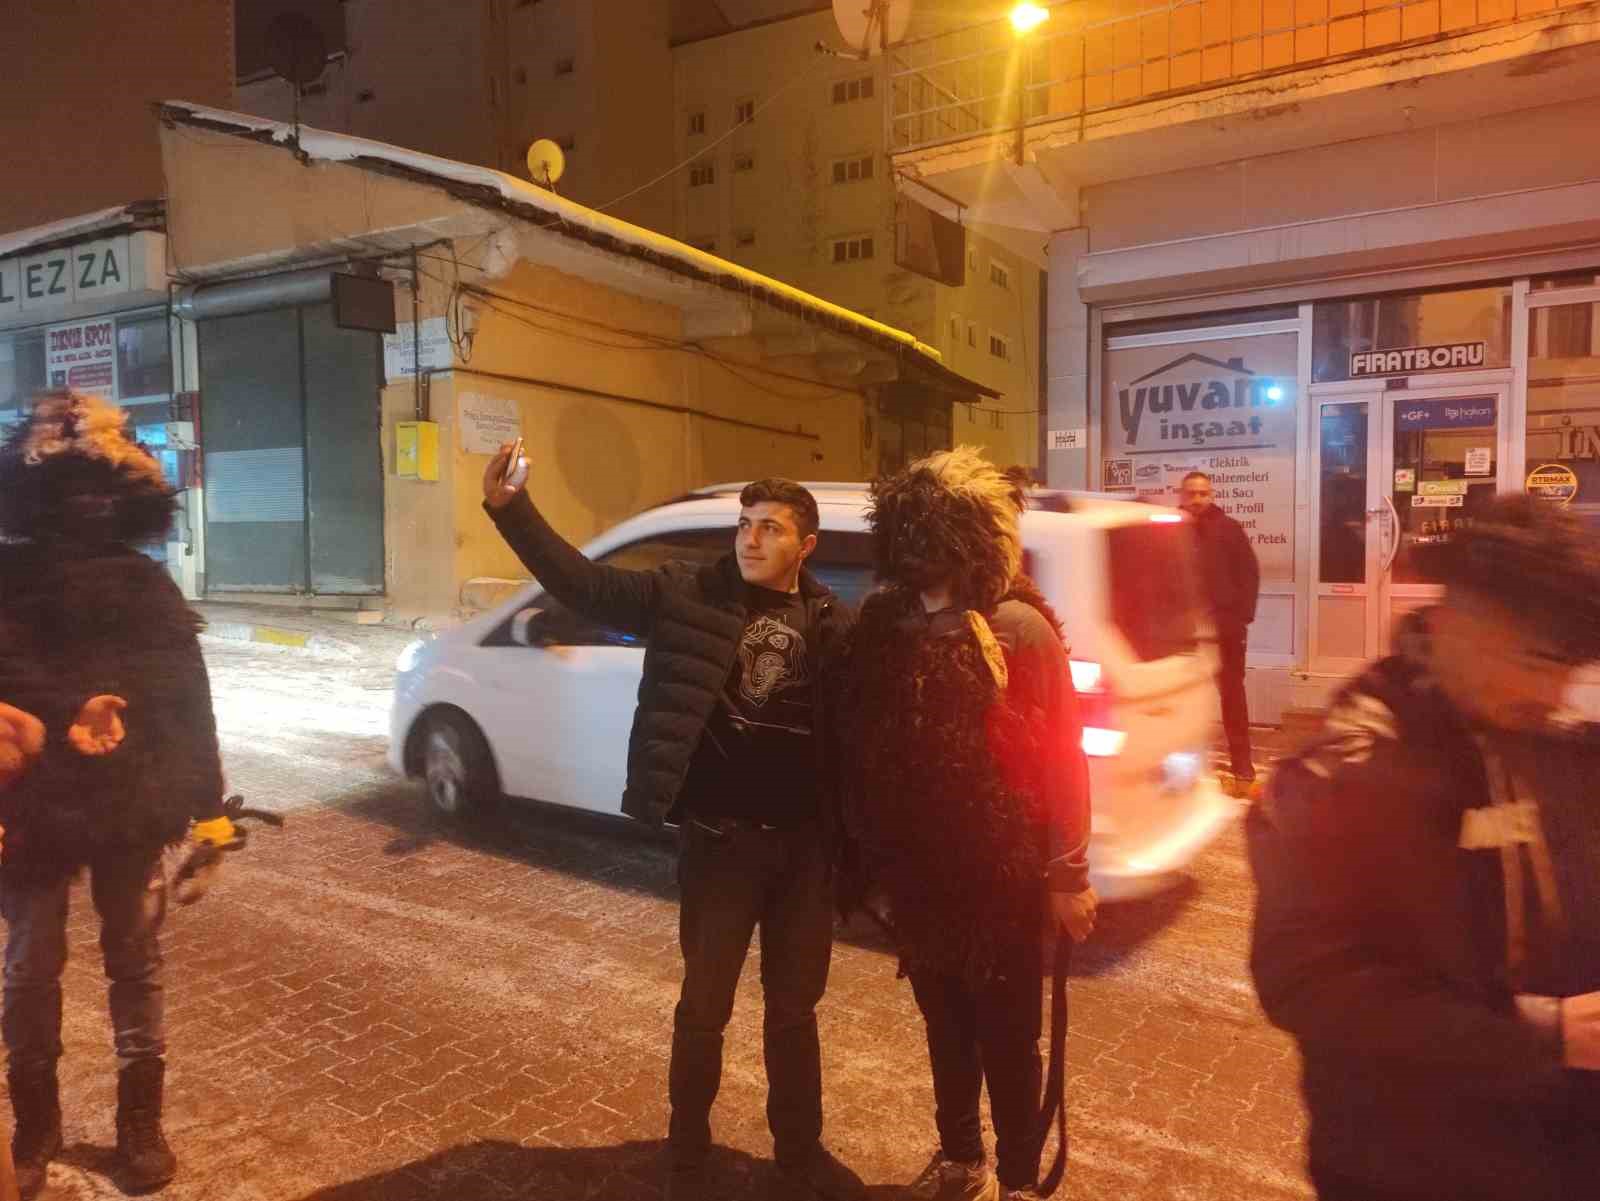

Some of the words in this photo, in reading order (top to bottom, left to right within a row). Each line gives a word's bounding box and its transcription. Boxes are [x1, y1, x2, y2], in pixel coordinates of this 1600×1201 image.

[1352, 343, 1483, 374] FIRATBORU
[1210, 456, 1250, 468] Elektrik
[1236, 502, 1264, 513] Profil
[1257, 532, 1287, 545] Petek
